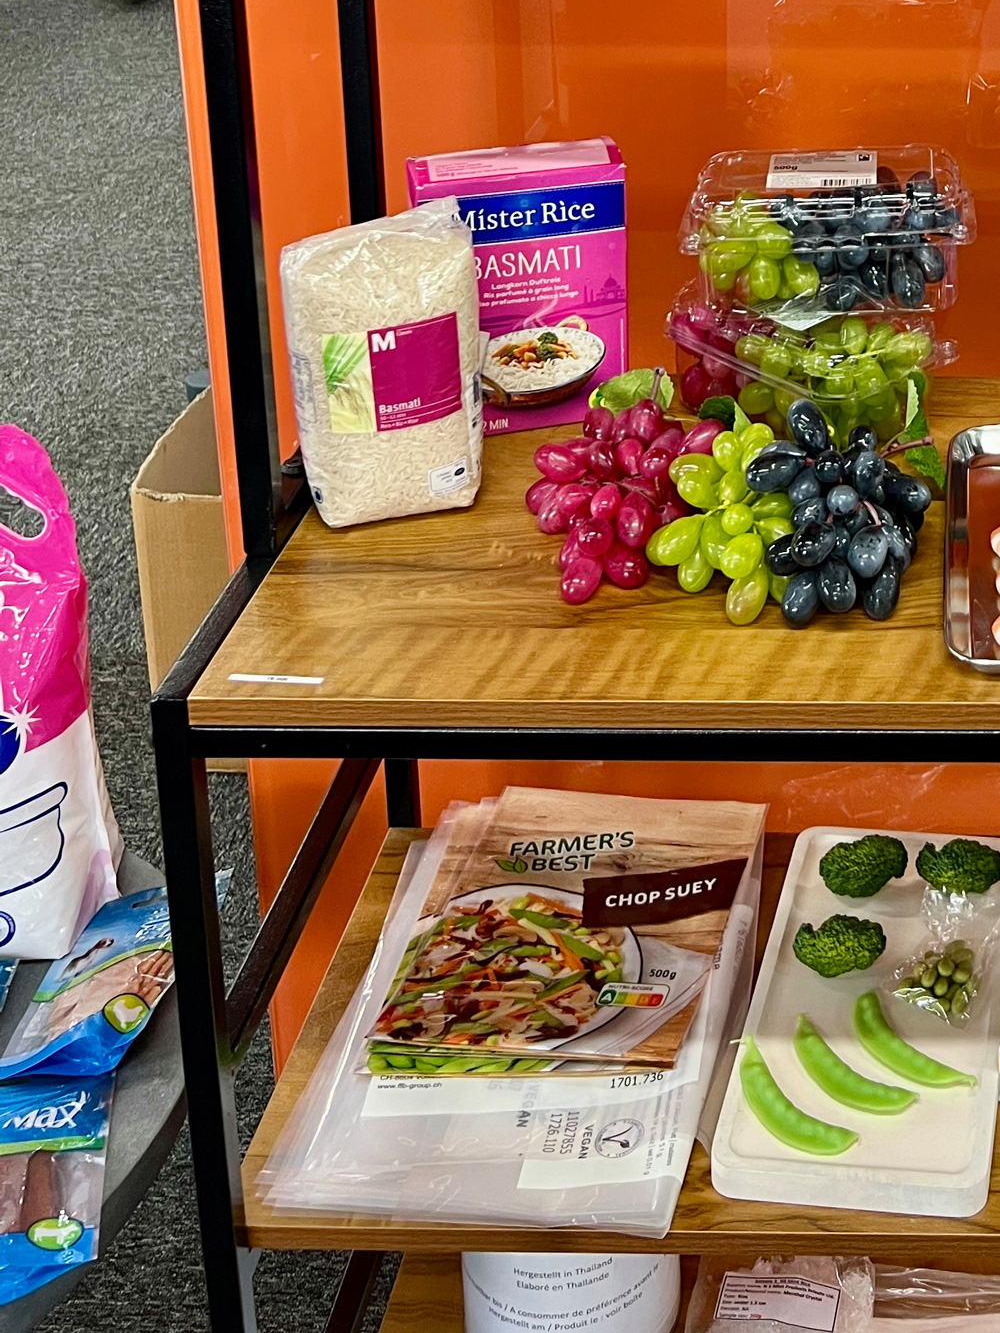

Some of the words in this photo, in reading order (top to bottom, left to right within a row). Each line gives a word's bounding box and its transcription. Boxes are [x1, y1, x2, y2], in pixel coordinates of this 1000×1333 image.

[371, 331, 396, 352] M
[379, 398, 421, 414] Basmati
[489, 418, 508, 430] MIN
[510, 832, 635, 857] FARMER'S
[531, 854, 596, 872] BEST
[605, 891, 660, 907] CHOP
[664, 878, 717, 901] SUEY
[649, 969, 677, 980] 500g
[610, 1071, 664, 1089] 1701.736
[543, 1113, 562, 1153] 1726.110
[561, 1111, 580, 1154] 11027855
[578, 1124, 595, 1160] VEGAN
[514, 1267, 561, 1279] Hergestellt
[576, 1257, 613, 1276] Thailand
[516, 1281, 549, 1291] Elaboré
[566, 1271, 609, 1289] Thailande
[518, 1310, 569, 1319] consommer
[572, 1309, 583, 1317] de
[586, 1288, 632, 1315] préférence
[606, 1307, 622, 1319] voir
[555, 1319, 587, 1331] Produit
